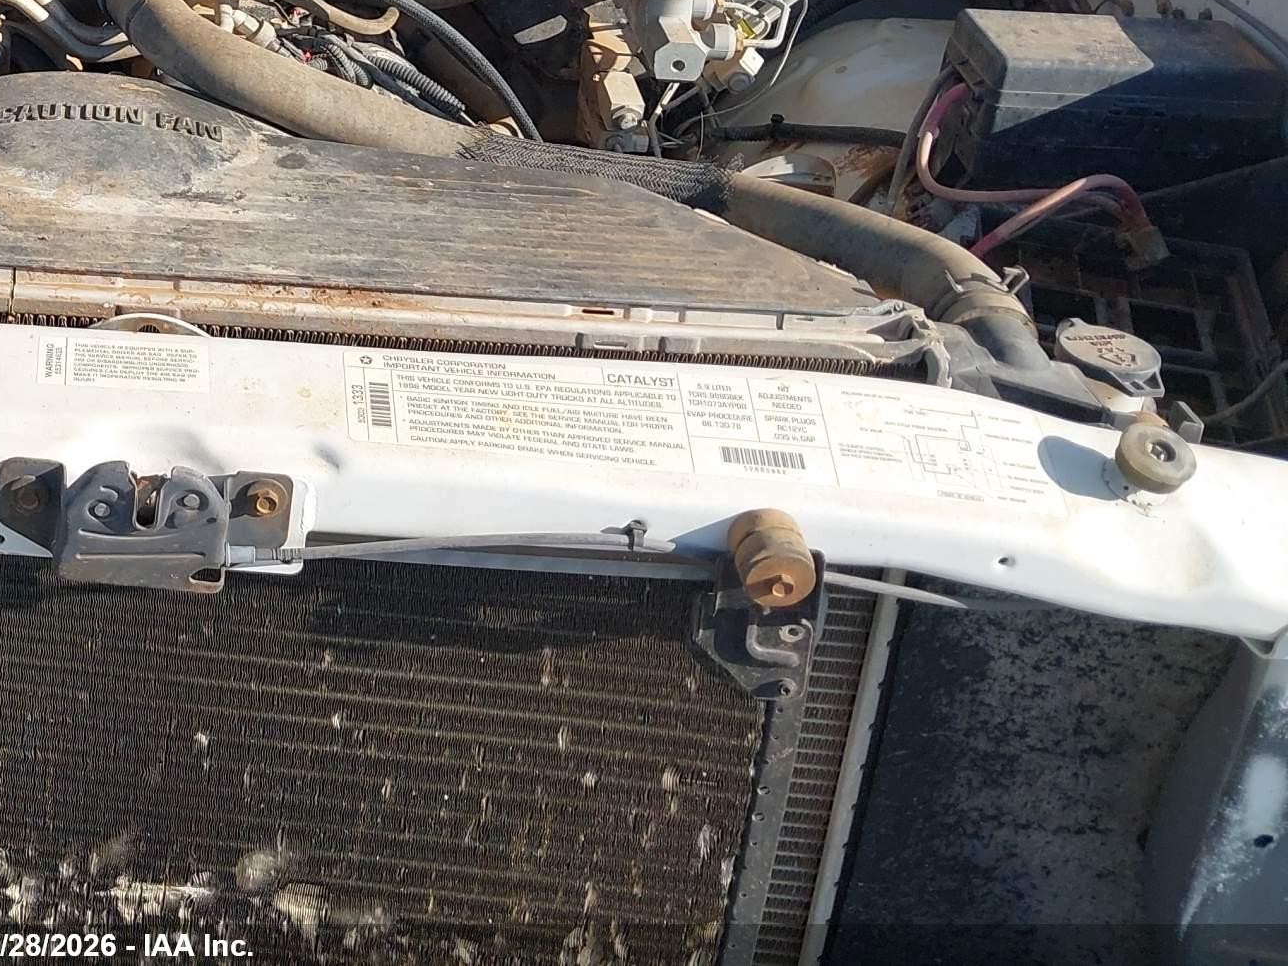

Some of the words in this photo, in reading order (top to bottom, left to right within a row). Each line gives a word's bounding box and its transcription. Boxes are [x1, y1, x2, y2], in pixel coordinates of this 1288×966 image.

[155, 110, 223, 142] FAN
[45, 343, 54, 378] WARNING
[382, 355, 433, 365] CHRYSLER
[437, 359, 506, 370] CORPORATION
[383, 362, 440, 373] IMPORTANT
[444, 367, 483, 376] VEHICLE
[487, 369, 556, 380] INFORMATION
[607, 373, 675, 387] CATALYST
[352, 384, 364, 405] 1333
[396, 374, 415, 382] THIS
[417, 376, 450, 385] VEHICLE
[453, 379, 500, 388] CONFORMS
[554, 386, 611, 396] REGULATIONS
[614, 390, 663, 400] APPLICABLE
[422, 384, 452, 392] MODEL
[455, 386, 475, 394] YEAR
[478, 388, 498, 396] NEW
[551, 392, 584, 402] TRUCKS
[712, 384, 731, 392] LITER
[758, 392, 812, 403] ADJUSTMENTS
[772, 402, 802, 410] NEEDED
[408, 409, 463, 419] PROCEDURES
[485, 415, 512, 423] OTHER
[515, 418, 562, 428] ADDITIONAL
[548, 414, 581, 423] SERVICE
[584, 417, 619, 426] MANUAL
[641, 423, 673, 431] PROPER
[583, 410, 618, 418] MIXTURE
[645, 415, 668, 423] BEEN
[708, 412, 753, 422] PROCEDURE
[764, 415, 790, 423] SPARK
[792, 417, 816, 425] PLUGS
[409, 419, 470, 429] ADJUSTMENTS
[473, 424, 496, 432] MADE
[512, 428, 540, 436] OTHER
[543, 431, 565, 439] THAN
[567, 433, 611, 443] APPROVED
[613, 438, 647, 447] SERVICE
[409, 425, 464, 435] PROCEDURES
[489, 432, 520, 441] VIOLATE
[524, 436, 558, 445] FEDERAL
[582, 442, 607, 451] STATE
[477, 441, 515, 450] PARKING
[518, 446, 545, 455] BRAKE
[547, 449, 573, 457] WHEN
[576, 452, 619, 463] SERVICING
